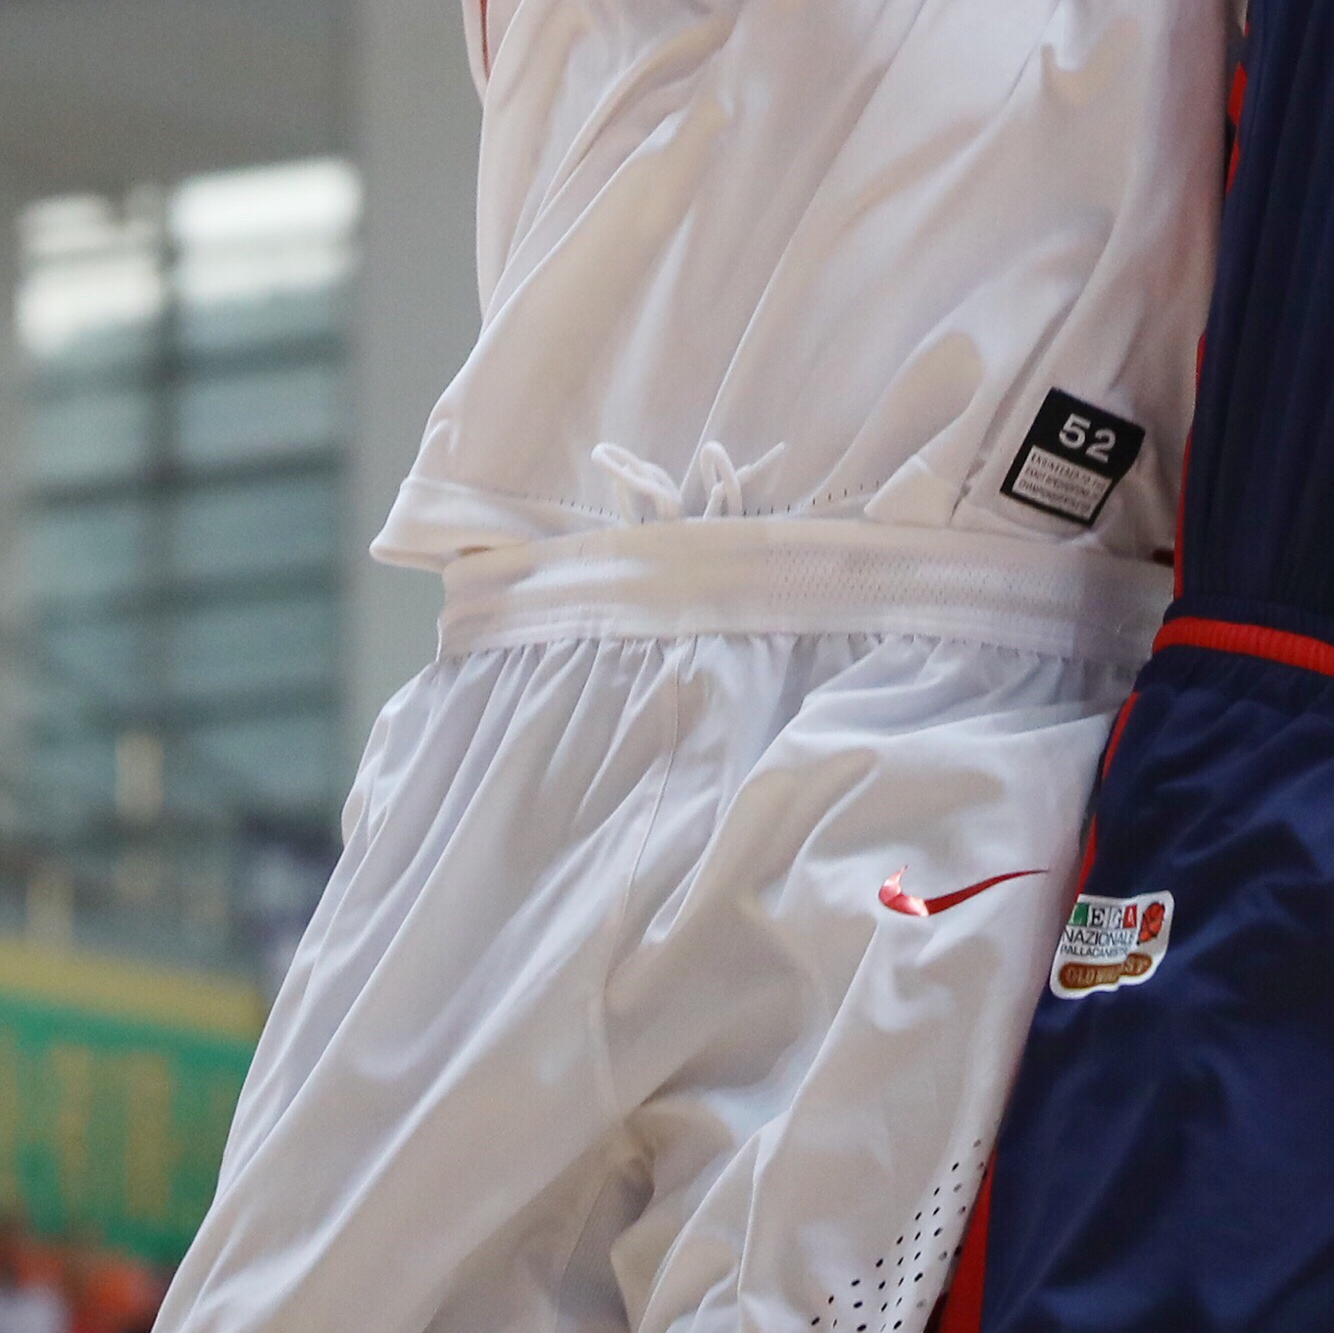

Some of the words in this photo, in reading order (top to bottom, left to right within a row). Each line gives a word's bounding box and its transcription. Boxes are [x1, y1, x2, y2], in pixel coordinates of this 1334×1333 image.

[1059, 413, 1116, 464] 52
[1067, 903, 1137, 928] LEGA
[1062, 928, 1134, 946] NAZIONALE
